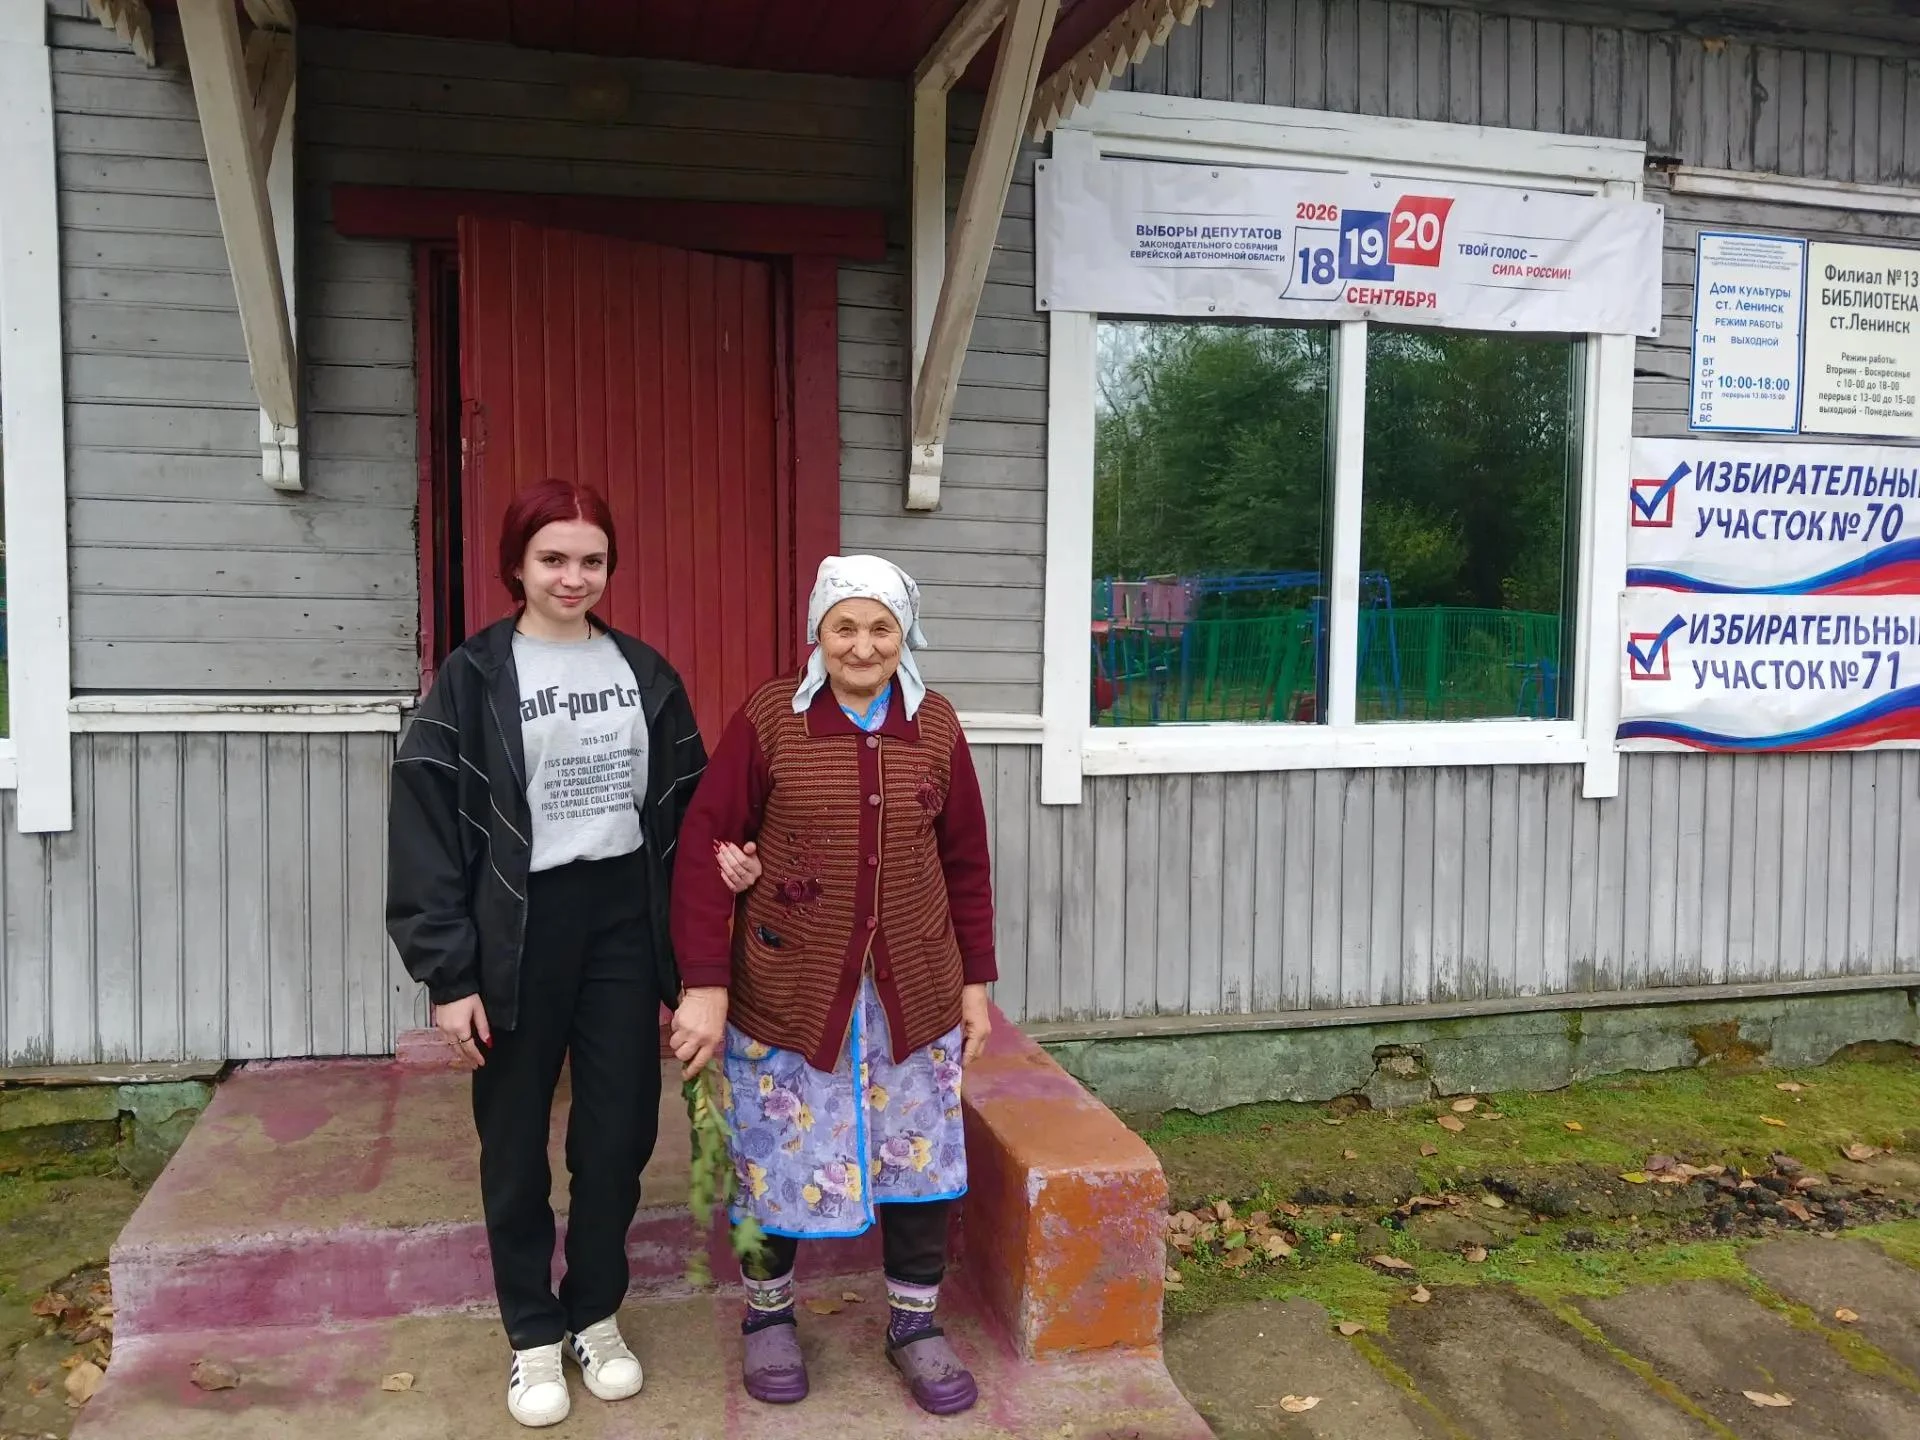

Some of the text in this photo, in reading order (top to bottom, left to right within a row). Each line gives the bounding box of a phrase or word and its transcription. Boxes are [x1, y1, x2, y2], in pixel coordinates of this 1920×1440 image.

[1296, 202, 1338, 221] 2026
[1136, 225, 1282, 239] ВЫБОРЫ ДЕПУТАТОВ
[1394, 211, 1441, 251] 20
[1139, 240, 1278, 251] ЗАКОНОДАТЕЛЬНОГО СОБРАНИЯ
[1345, 228, 1384, 266] 19
[1458, 243, 1489, 257] ТВОЙ
[1490, 247, 1527, 260] ГОЛОС
[1130, 250, 1285, 262] ЕВРЕЙСКОЙ АВТОНОМНОЙ ОБЛАСТИ
[1298, 247, 1336, 285] 18
[1492, 264, 1571, 279] СИЛА РОССИИ!
[1825, 264, 1919, 287] Филиал №13
[1346, 286, 1437, 308] СЕНТЯБРЯ
[1710, 282, 1791, 299] Дом культуры
[1715, 300, 1784, 313] ст. Ленинск
[1822, 288, 1919, 312] БИБЛИОТЕКА
[1715, 318, 1783, 329] РЕЖИМ РАБОТЫ
[1830, 313, 1910, 333] ст.Ленинск
[1702, 335, 1779, 347] ПН ВЫХОДНОЙ
[1702, 357, 1714, 366] ВТ
[1841, 352, 1867, 362] Режим
[1702, 369, 1714, 377] СР
[1826, 364, 1857, 375] Вторник
[1864, 367, 1911, 378] Воскресенье
[1702, 380, 1713, 389] ЧТ
[1718, 376, 1790, 391] 10:00-18:00
[1866, 382, 1877, 390] до
[1701, 392, 1713, 400] ПТ
[1818, 392, 1851, 402] перерыв
[1882, 396, 1892, 404] до
[1700, 403, 1713, 411] СБ
[1819, 405, 1857, 415] выходной
[1864, 406, 1913, 418] Понедельник
[1700, 414, 1712, 423] ВС
[1695, 460, 1920, 499] ИЗБИРАТЕЛЬНЫ
[1695, 506, 1826, 541] УЧАСТОК
[1688, 613, 1920, 646] ИЗБИРАТЕЛЬНЫ
[1691, 659, 1826, 690] УЧАСТОК
[580, 731, 618, 746] 2015-2017
[562, 755, 591, 767] CAPSULE
